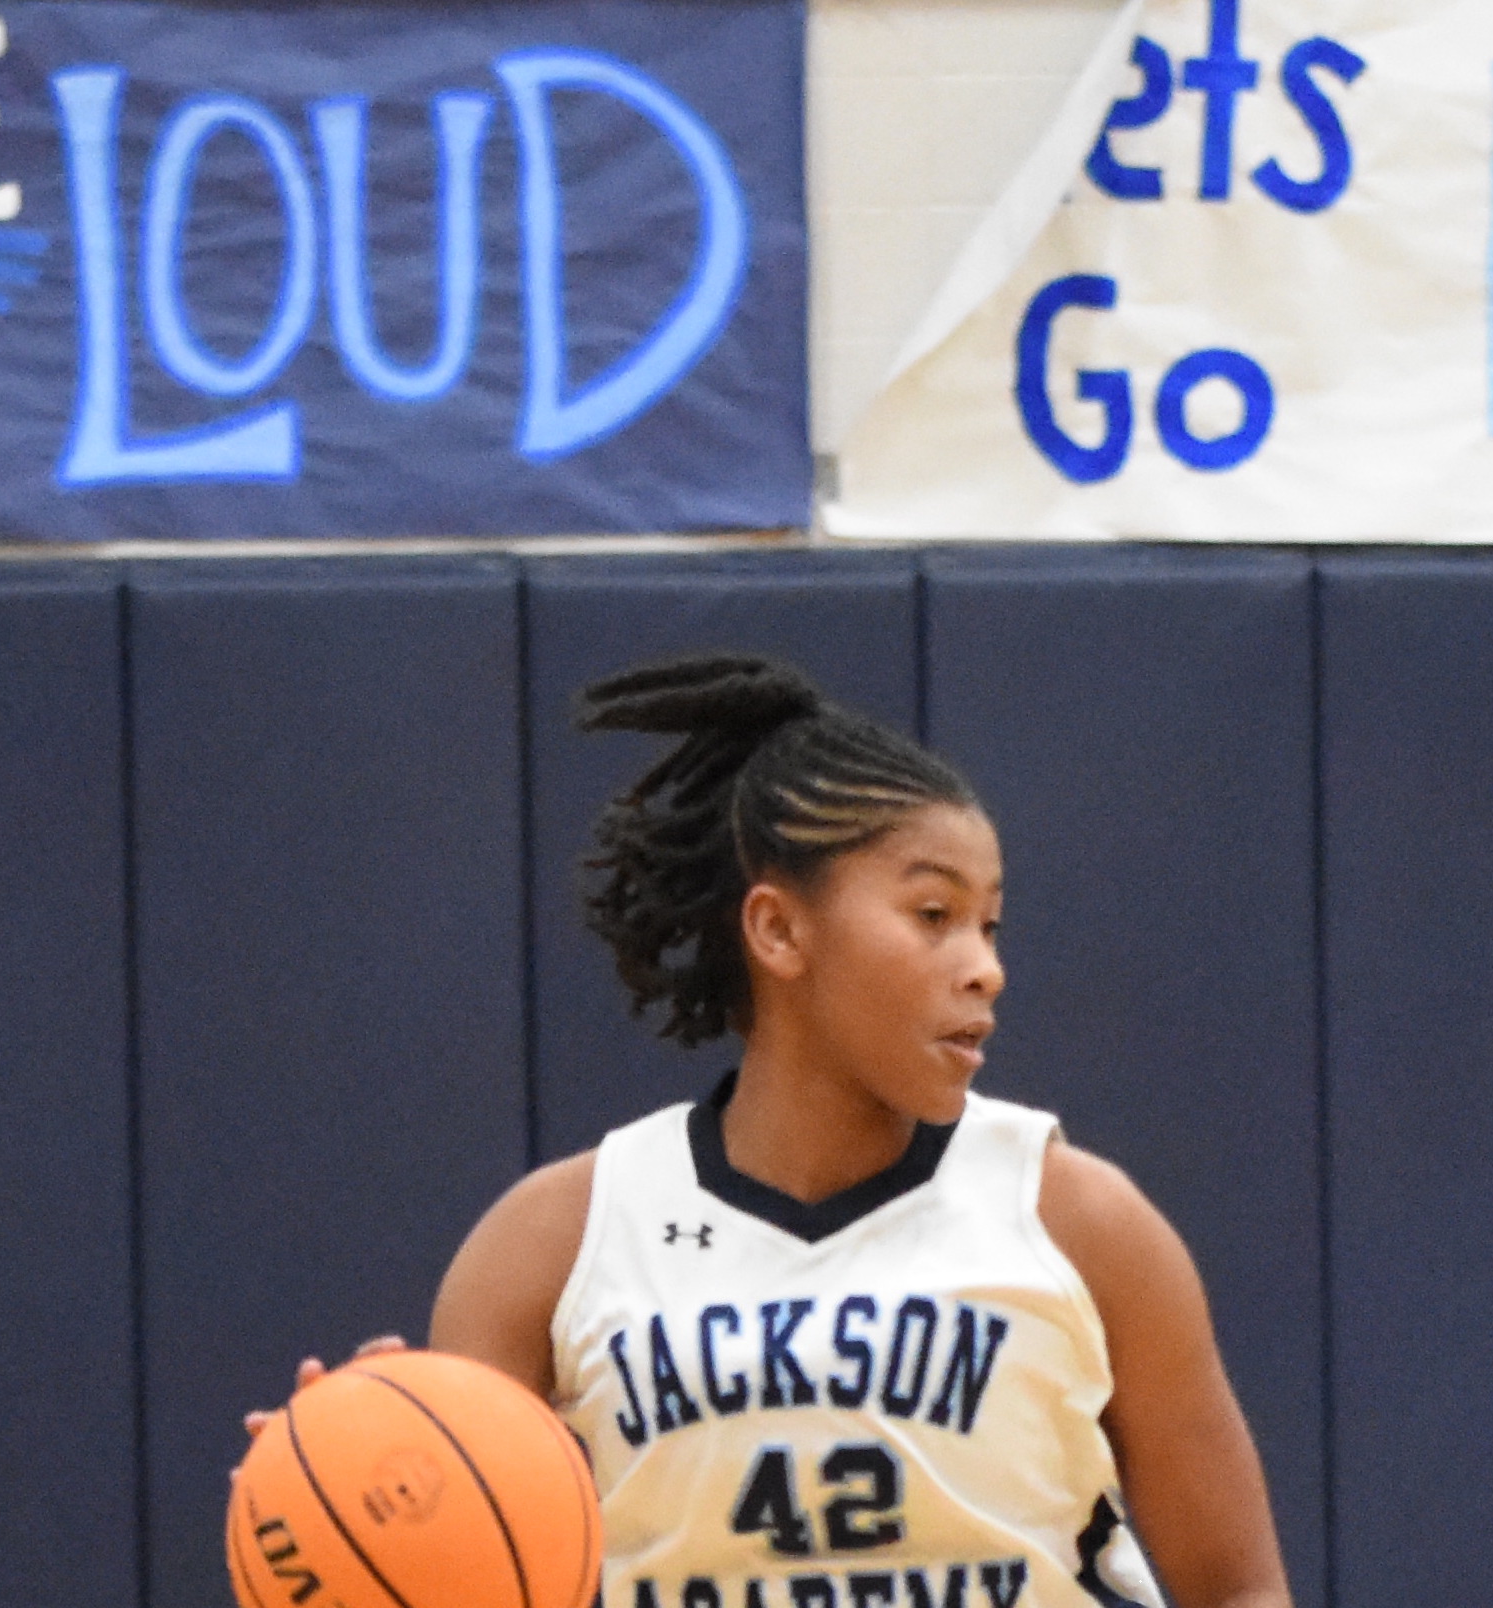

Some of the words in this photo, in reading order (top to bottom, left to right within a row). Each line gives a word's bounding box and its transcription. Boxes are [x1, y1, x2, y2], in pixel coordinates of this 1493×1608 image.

[50, 46, 749, 484] LOUD
[1015, 273, 1274, 482] Go
[608, 1293, 1010, 1449] JACKSON
[727, 1437, 905, 1558] 42
